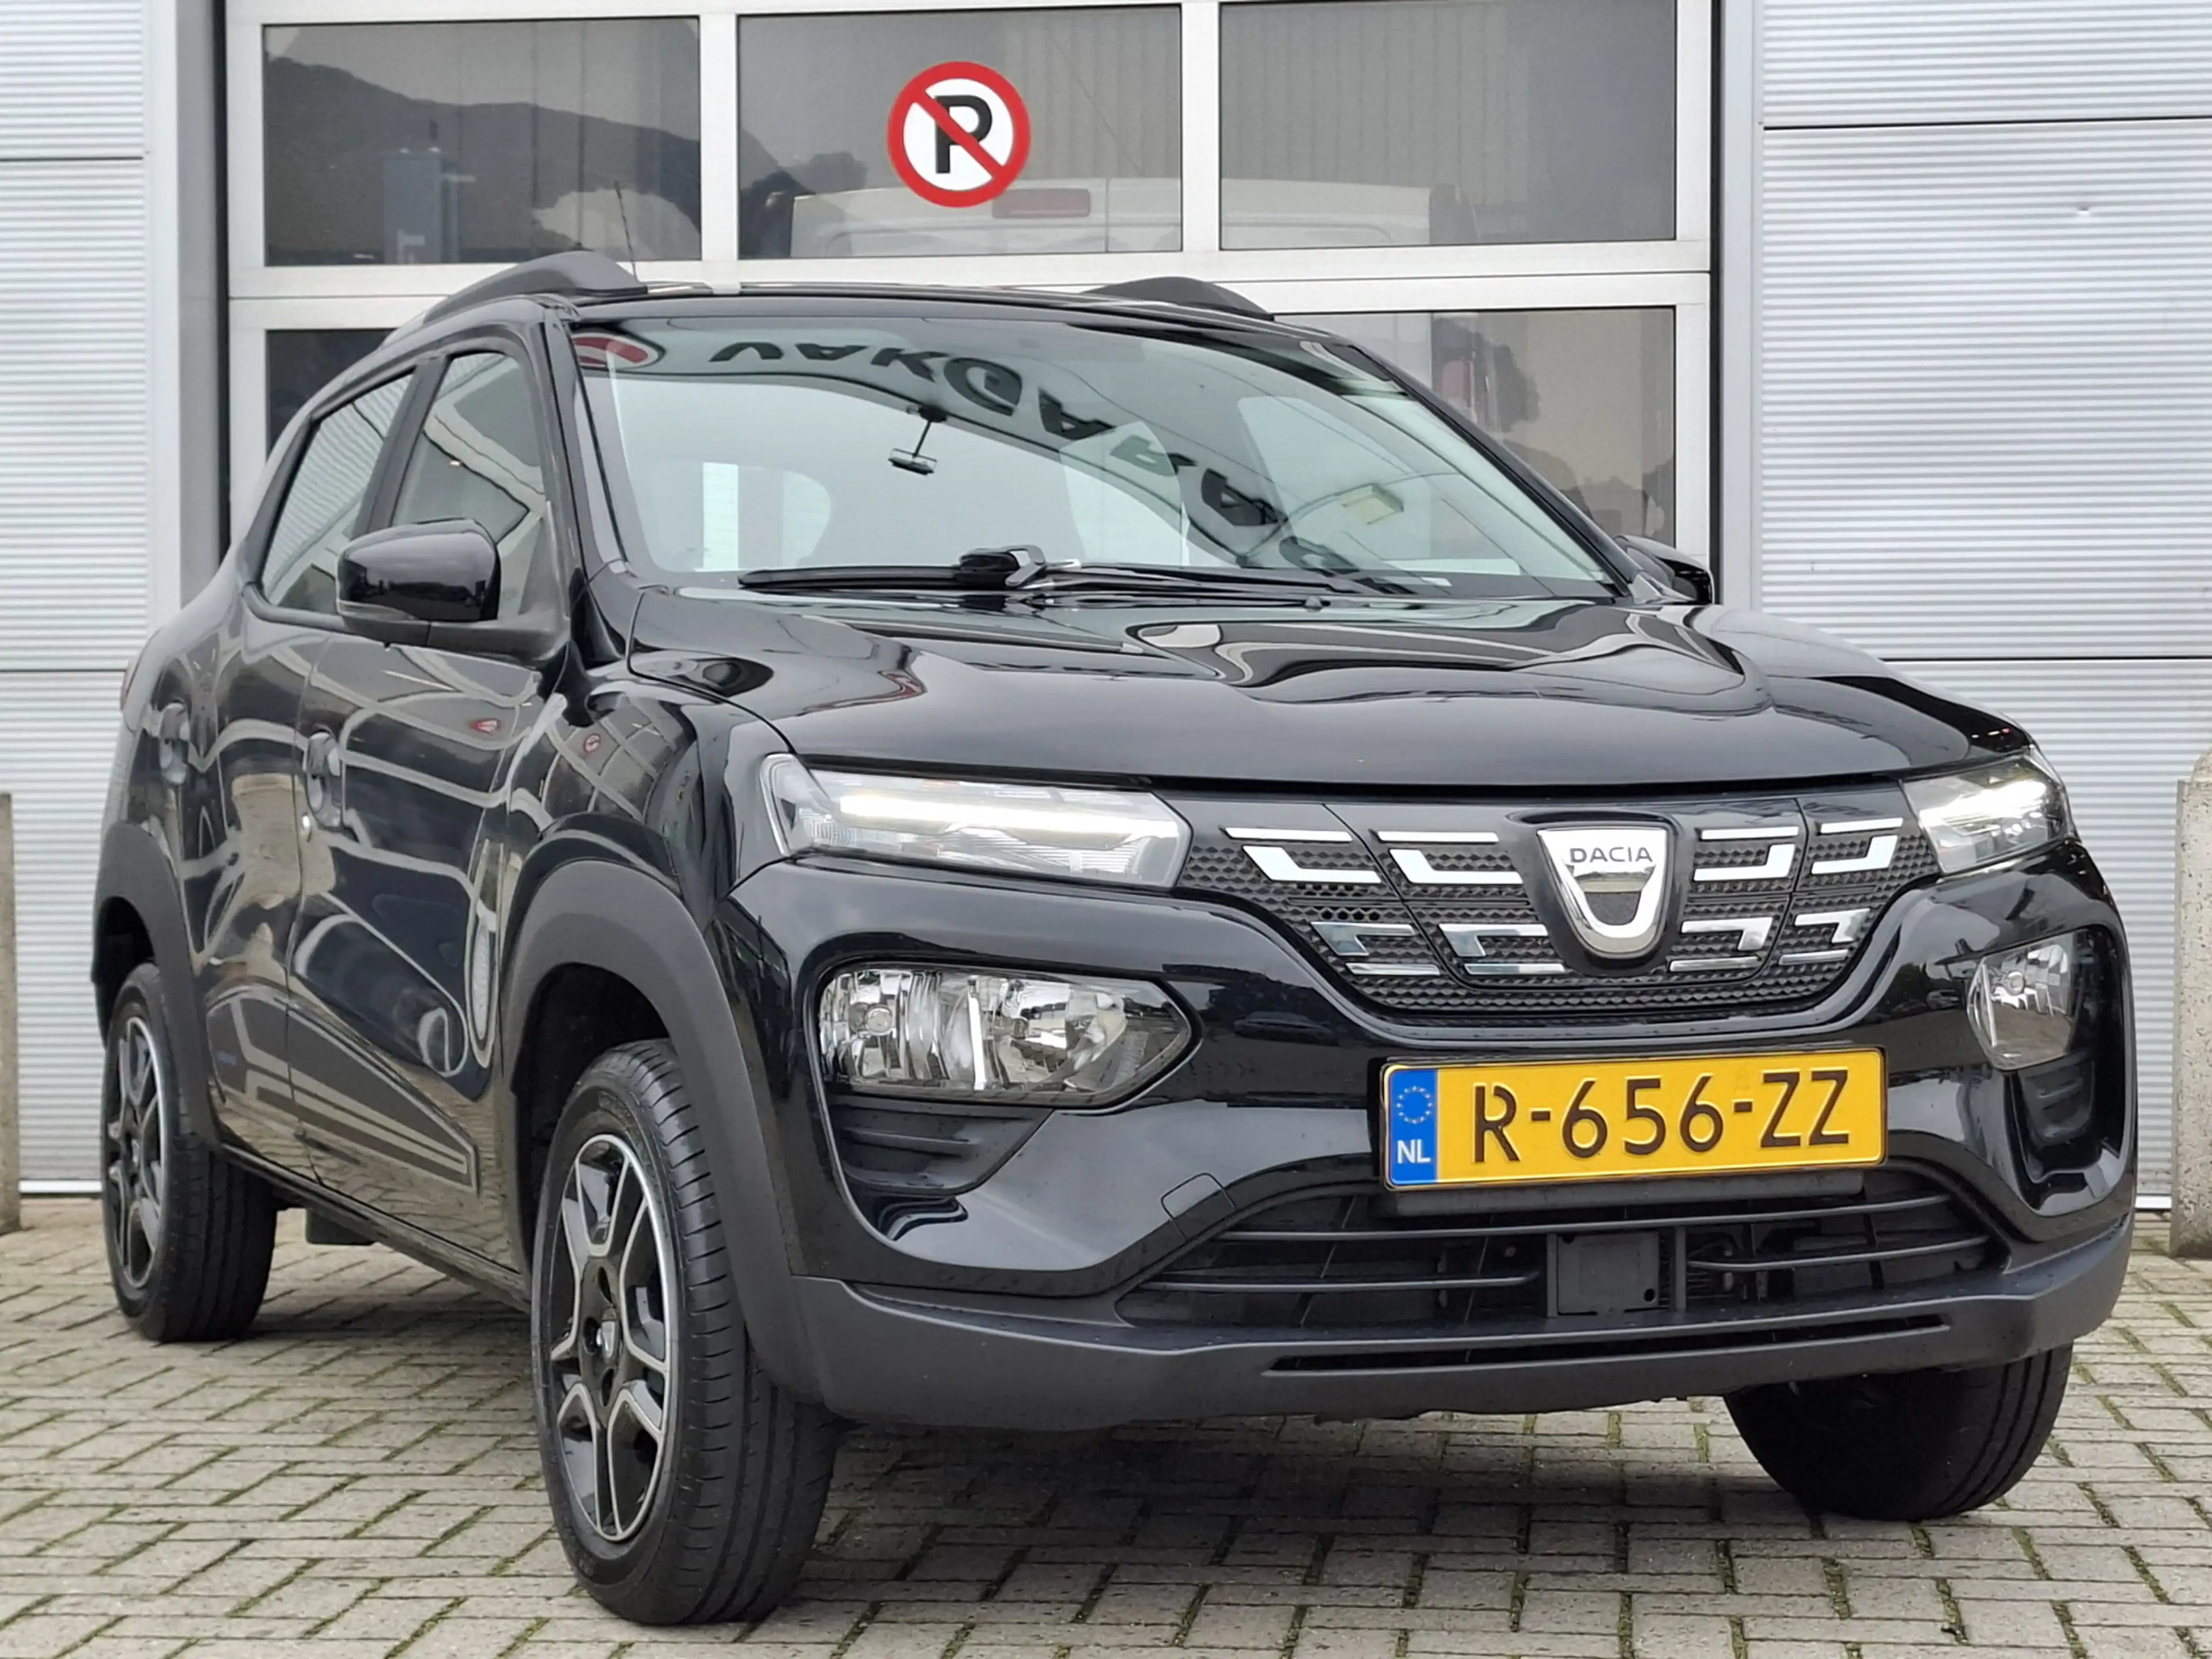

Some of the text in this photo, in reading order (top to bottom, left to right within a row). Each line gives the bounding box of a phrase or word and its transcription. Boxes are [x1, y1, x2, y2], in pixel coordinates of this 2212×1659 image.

[935, 94, 993, 174] P
[1570, 846, 1653, 863] DACIA
[1472, 1067, 1850, 1163] R-656-ZZ
[1397, 1138, 1431, 1164] NL
